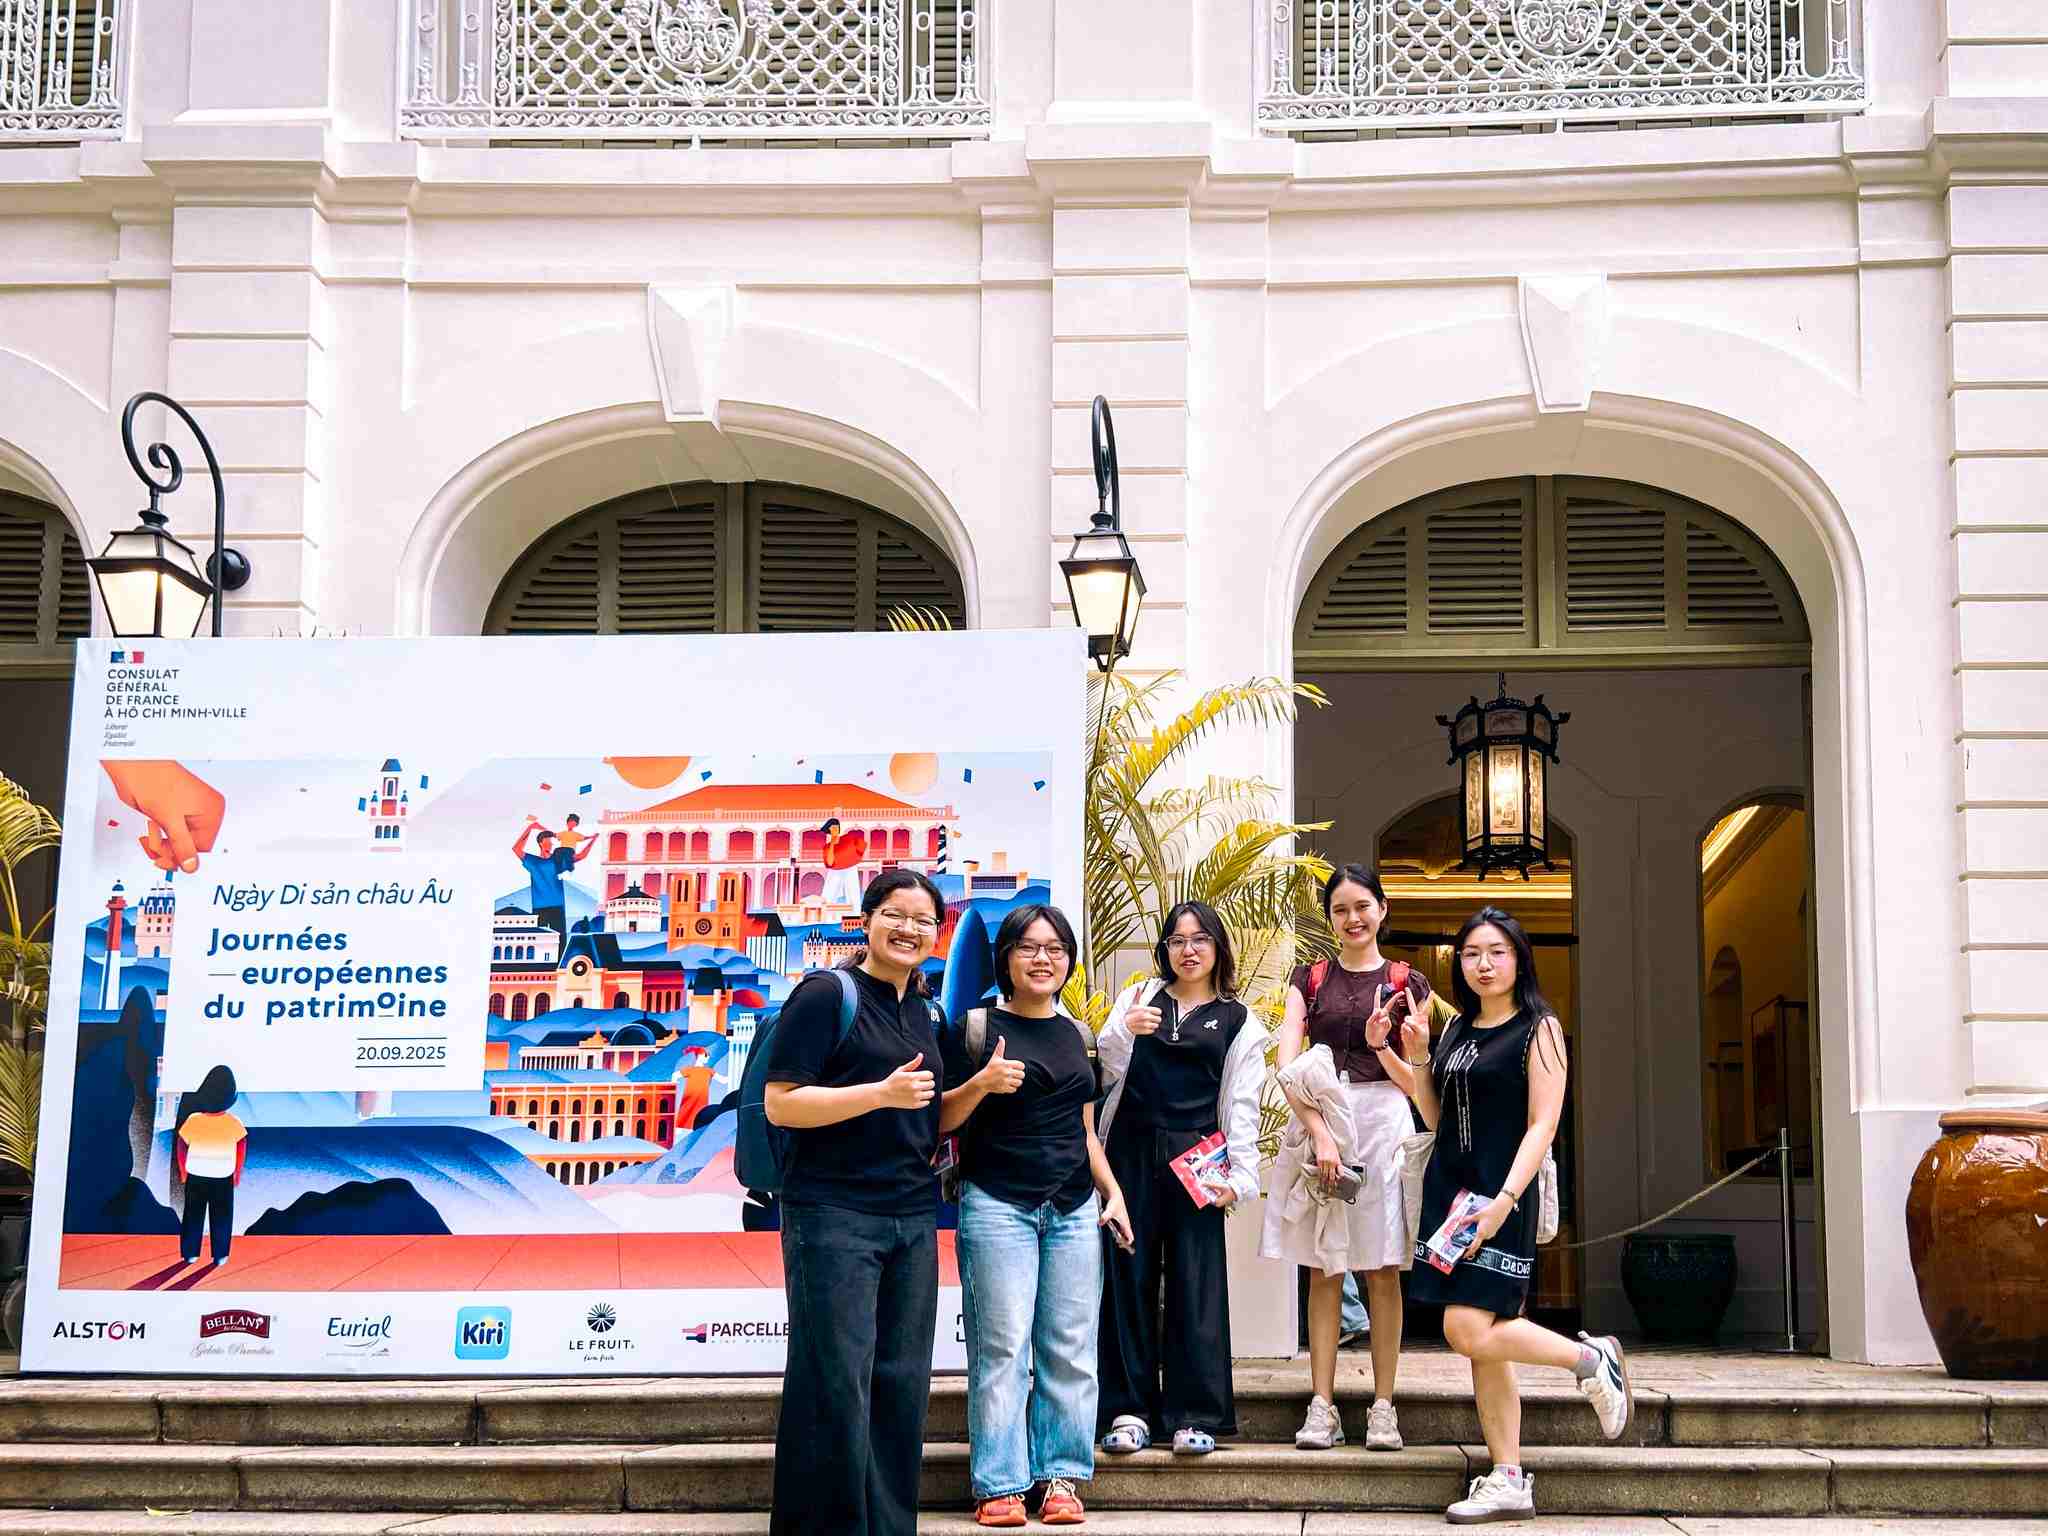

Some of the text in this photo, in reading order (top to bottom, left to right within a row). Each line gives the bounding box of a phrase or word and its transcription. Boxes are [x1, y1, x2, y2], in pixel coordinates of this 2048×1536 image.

[107, 668, 180, 680] CONSULAT
[106, 680, 168, 692] GÉNÉRAL
[105, 694, 180, 705] DE FRANCE
[104, 706, 248, 719] À HÔ CHI MINH-VILLE
[213, 878, 453, 912] Ngày Di sản châu Âu
[206, 925, 348, 957] Journées
[241, 959, 449, 991] européennes
[203, 992, 448, 1026] du patrimoine
[355, 1045, 447, 1061] 20.09.2025
[52, 1320, 146, 1340] ALSTOM
[327, 1315, 392, 1338] Eurial
[463, 1320, 504, 1345] Kiri
[568, 1339, 632, 1351] LE FRUIT
